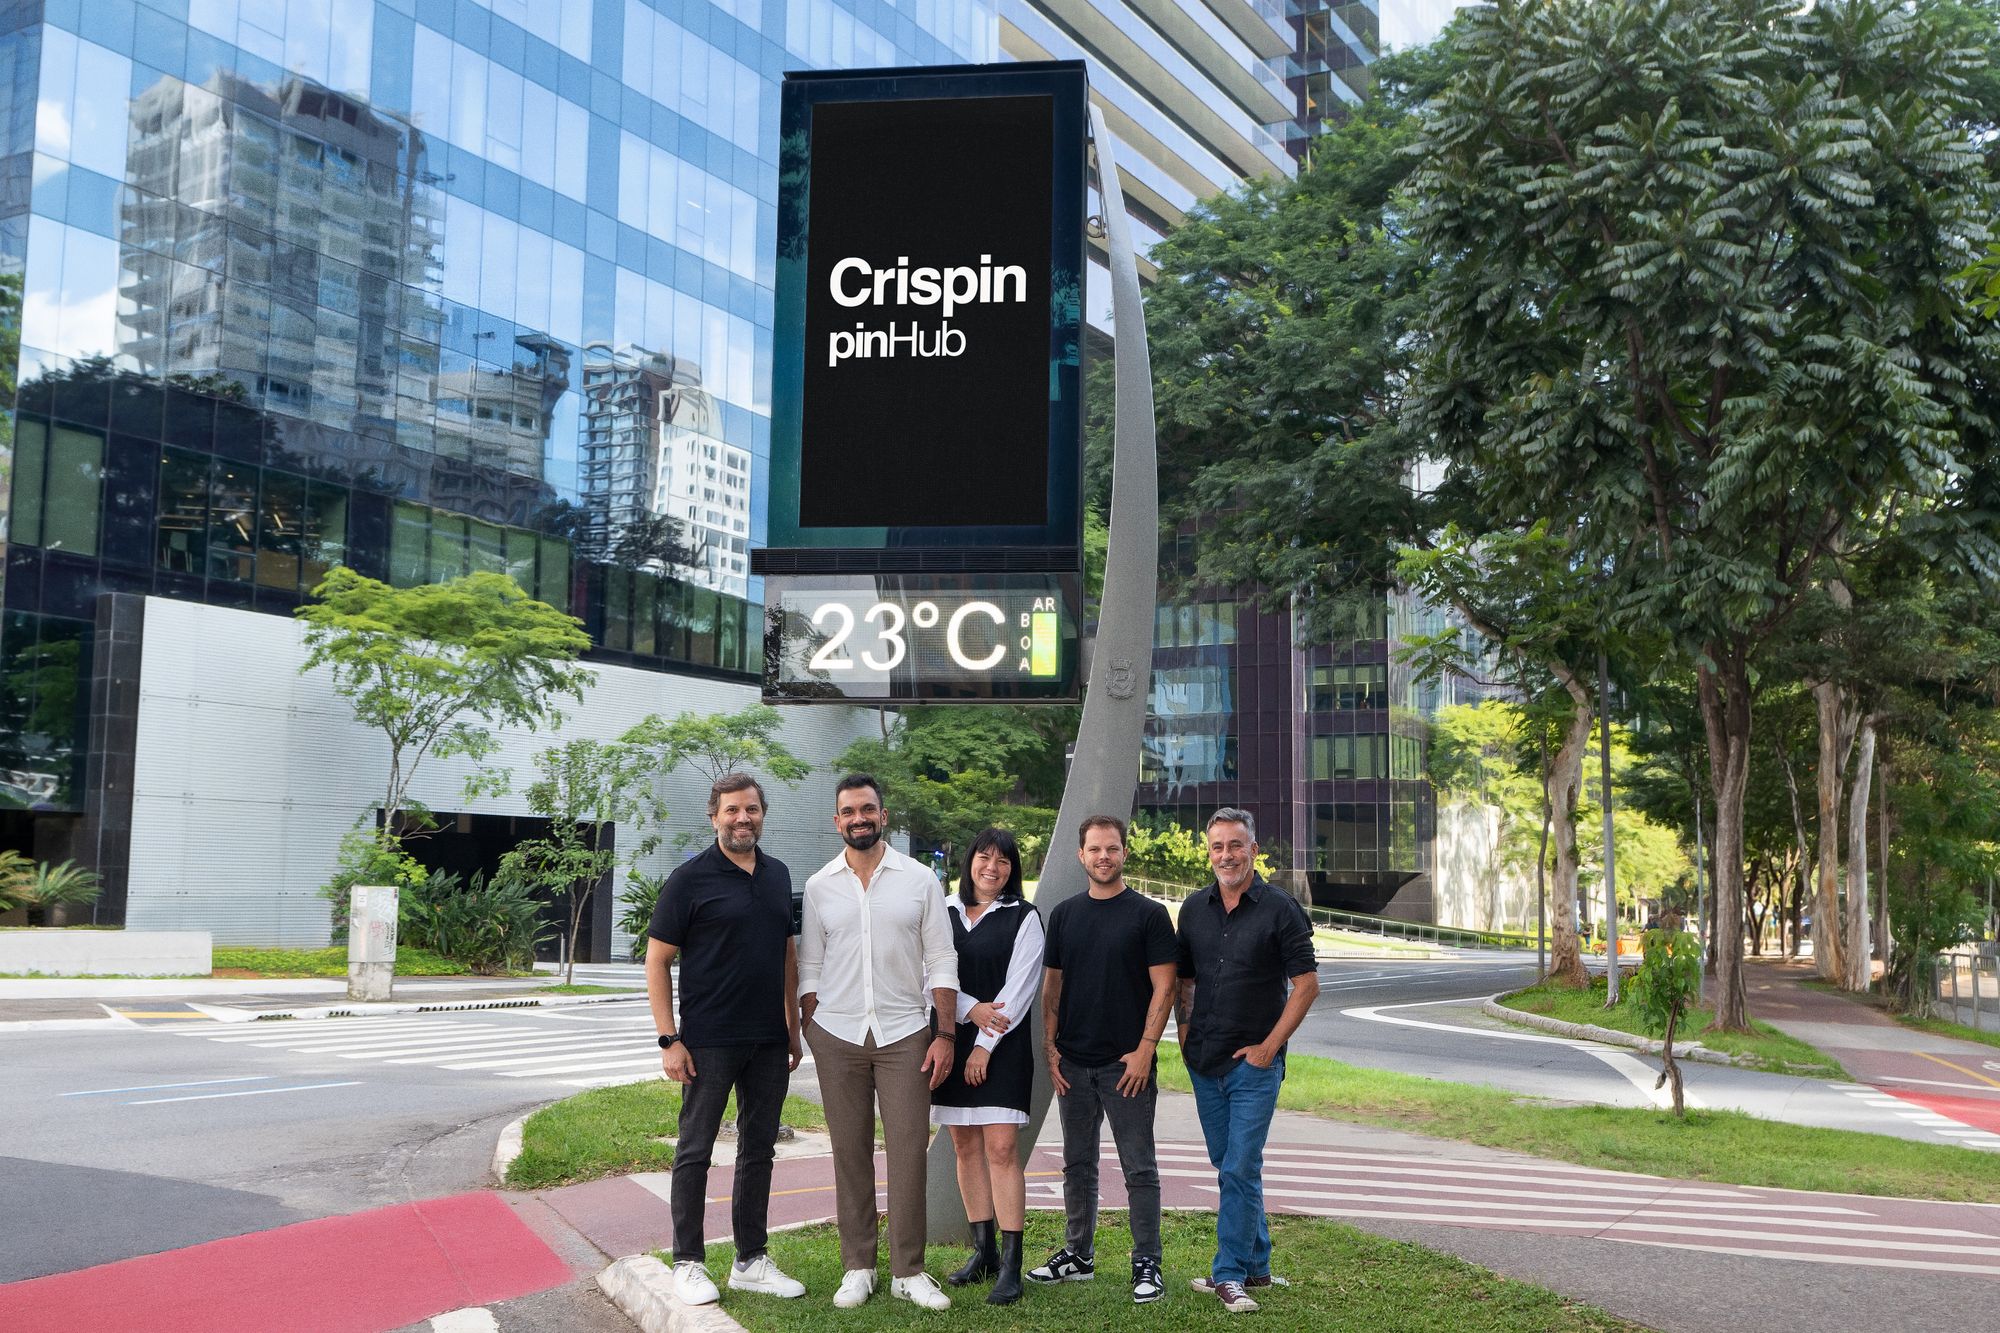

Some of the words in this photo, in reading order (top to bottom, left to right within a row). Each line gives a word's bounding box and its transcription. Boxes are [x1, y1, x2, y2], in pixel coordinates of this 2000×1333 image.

[829, 254, 1027, 318] Crispin
[828, 320, 967, 367] pinHub
[1032, 597, 1056, 612] AR
[808, 601, 1006, 671] 23°C
[1019, 613, 1031, 672] BOA
